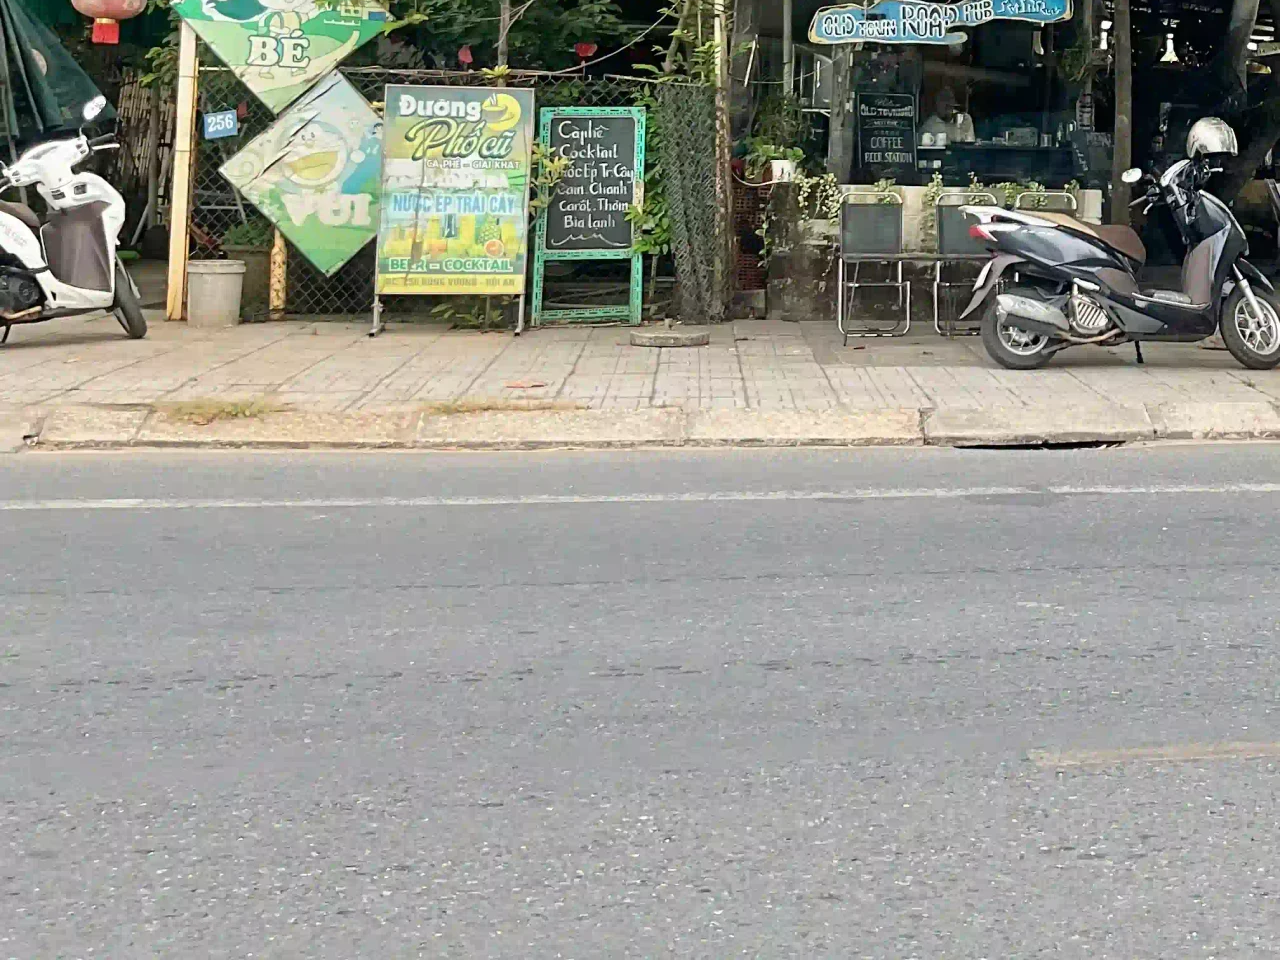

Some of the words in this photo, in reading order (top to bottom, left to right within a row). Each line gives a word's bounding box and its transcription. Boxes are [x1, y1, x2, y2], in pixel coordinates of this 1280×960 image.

[823, 13, 857, 37] OLD
[963, 0, 993, 23] PUB
[246, 29, 310, 67] BÉ
[207, 114, 233, 132] 256
[404, 117, 487, 161] Phố
[478, 130, 516, 158] cũ
[870, 136, 904, 149] COFFEE
[884, 152, 913, 163] STATION
[279, 191, 374, 227] VUI
[564, 214, 585, 229] Bia
[443, 257, 513, 272] COCKTAIL
